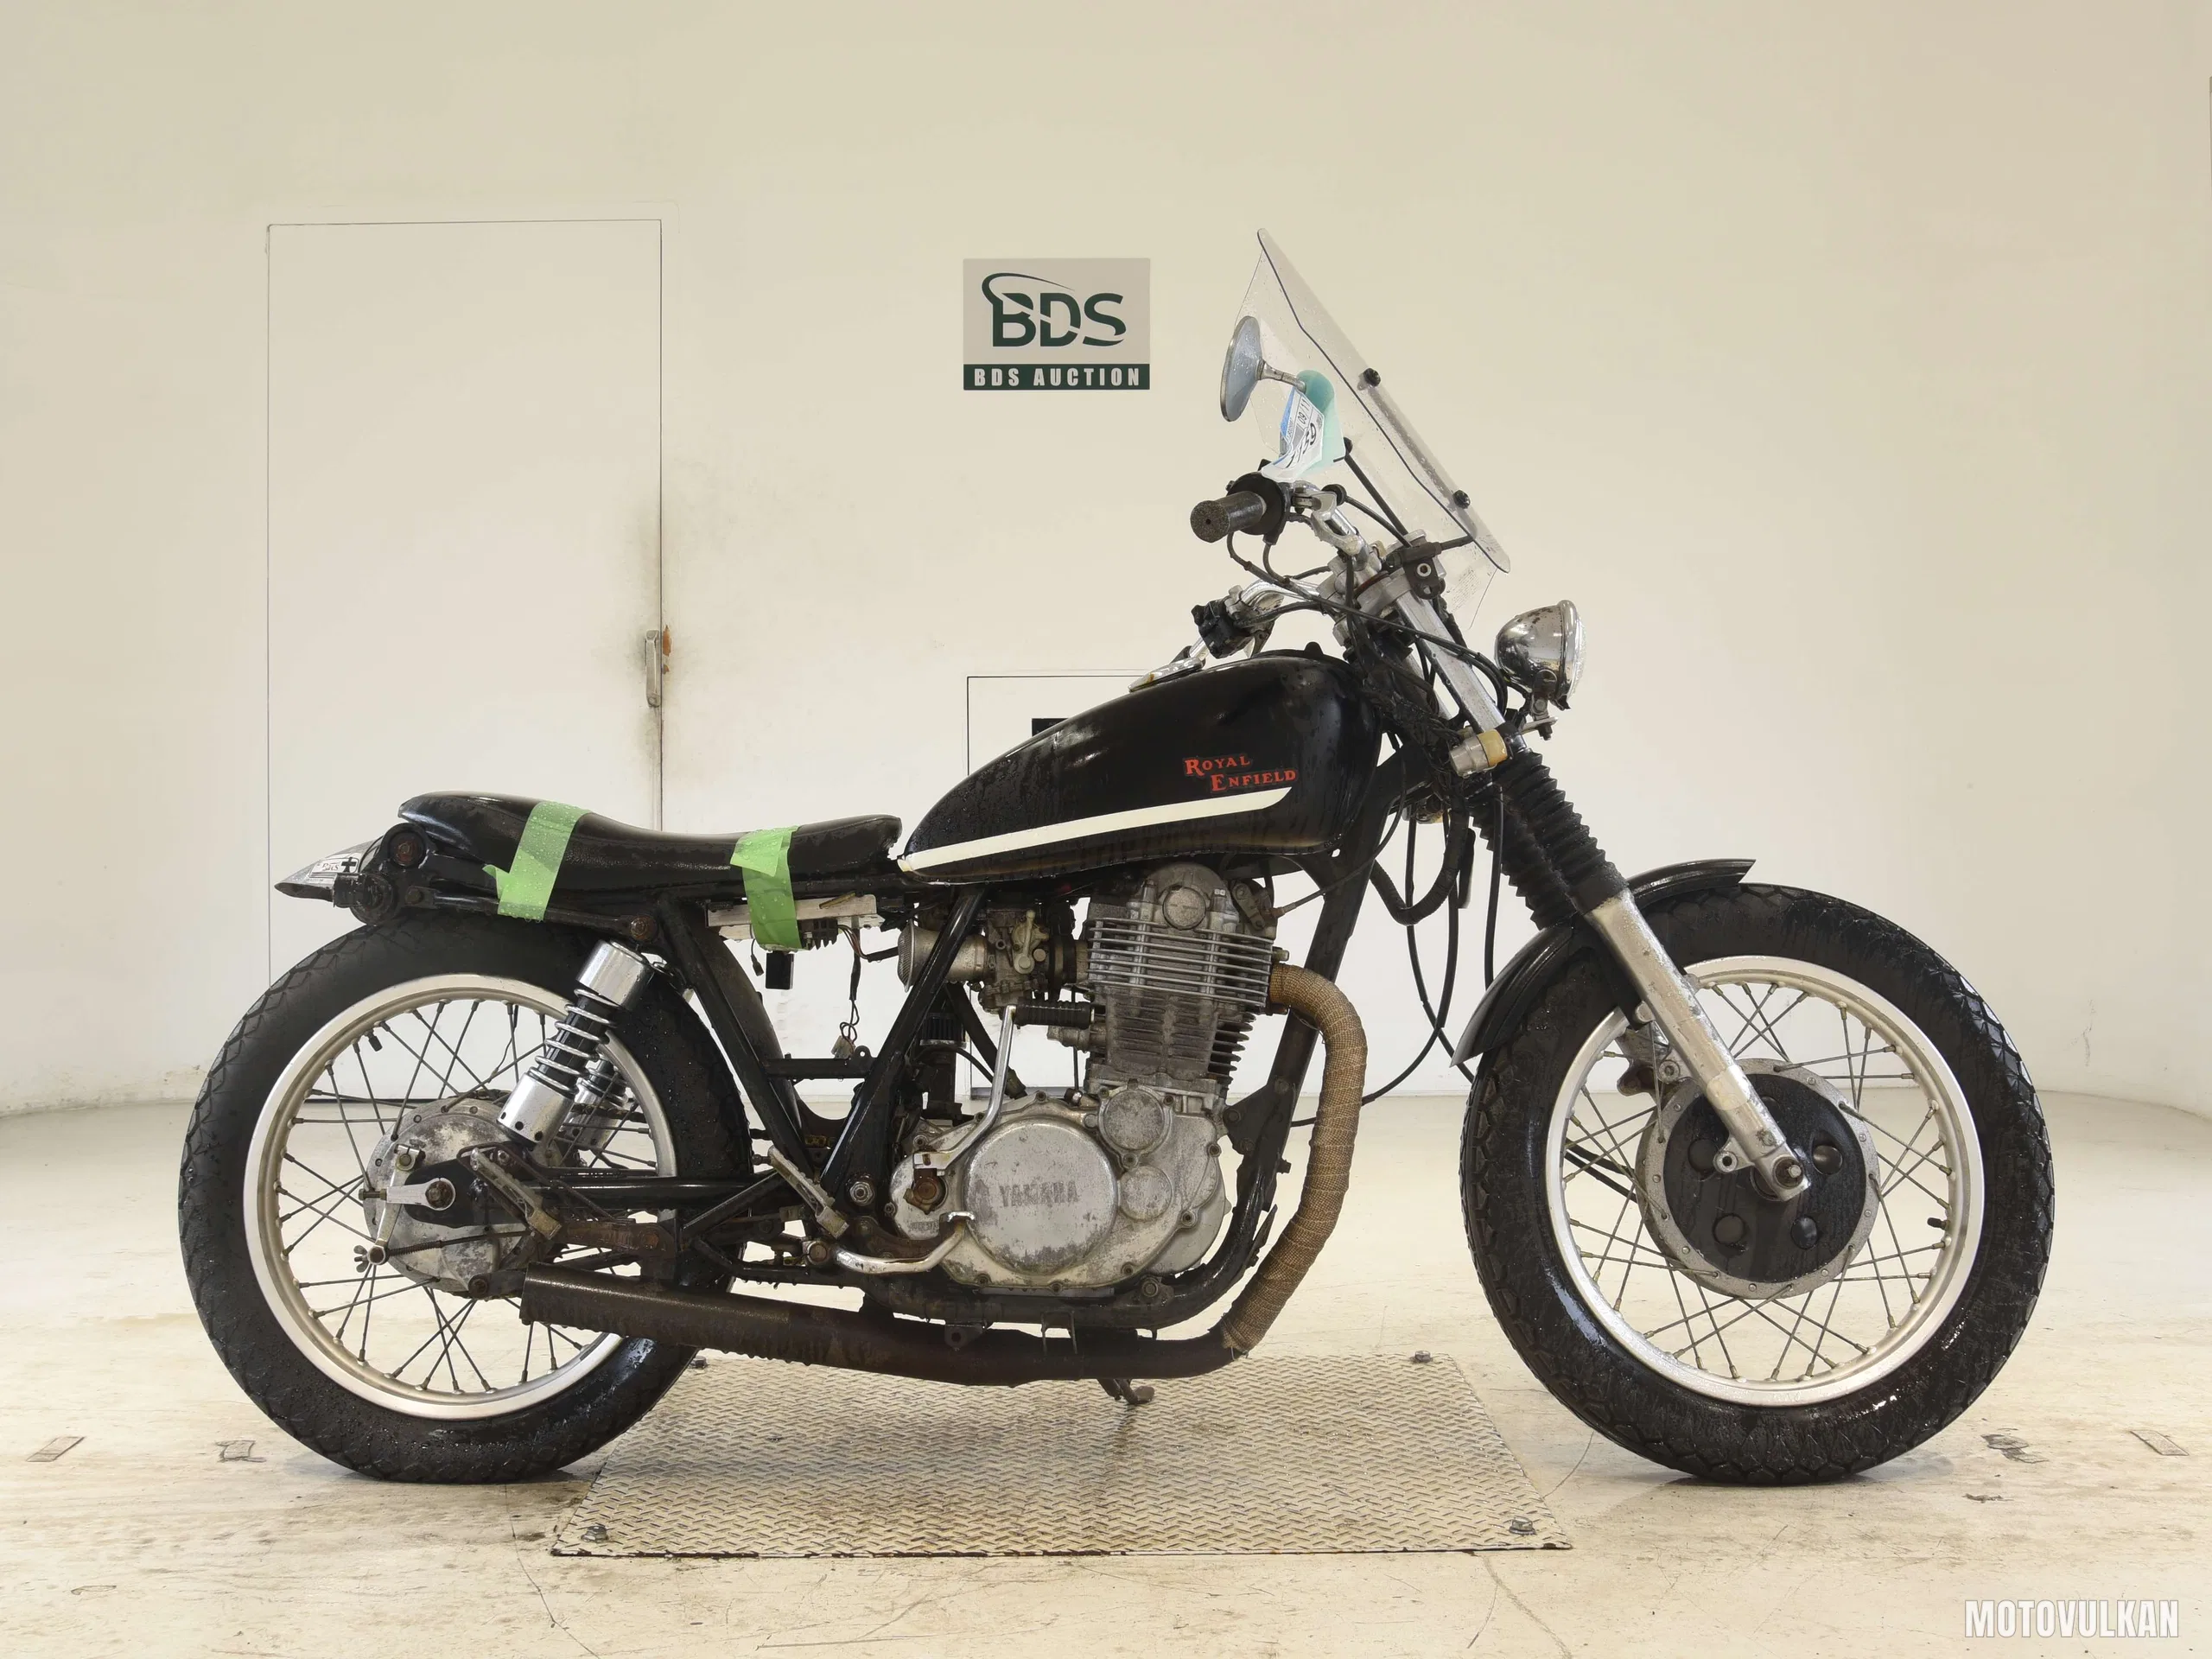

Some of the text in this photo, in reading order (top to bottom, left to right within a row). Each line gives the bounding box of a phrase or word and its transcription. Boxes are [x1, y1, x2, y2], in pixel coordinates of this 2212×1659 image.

[982, 272, 1127, 346] BDS
[974, 367, 1140, 386] BDS AUCTION
[1185, 755, 1250, 777] ROYAL
[1211, 770, 1296, 791] ENFIELD
